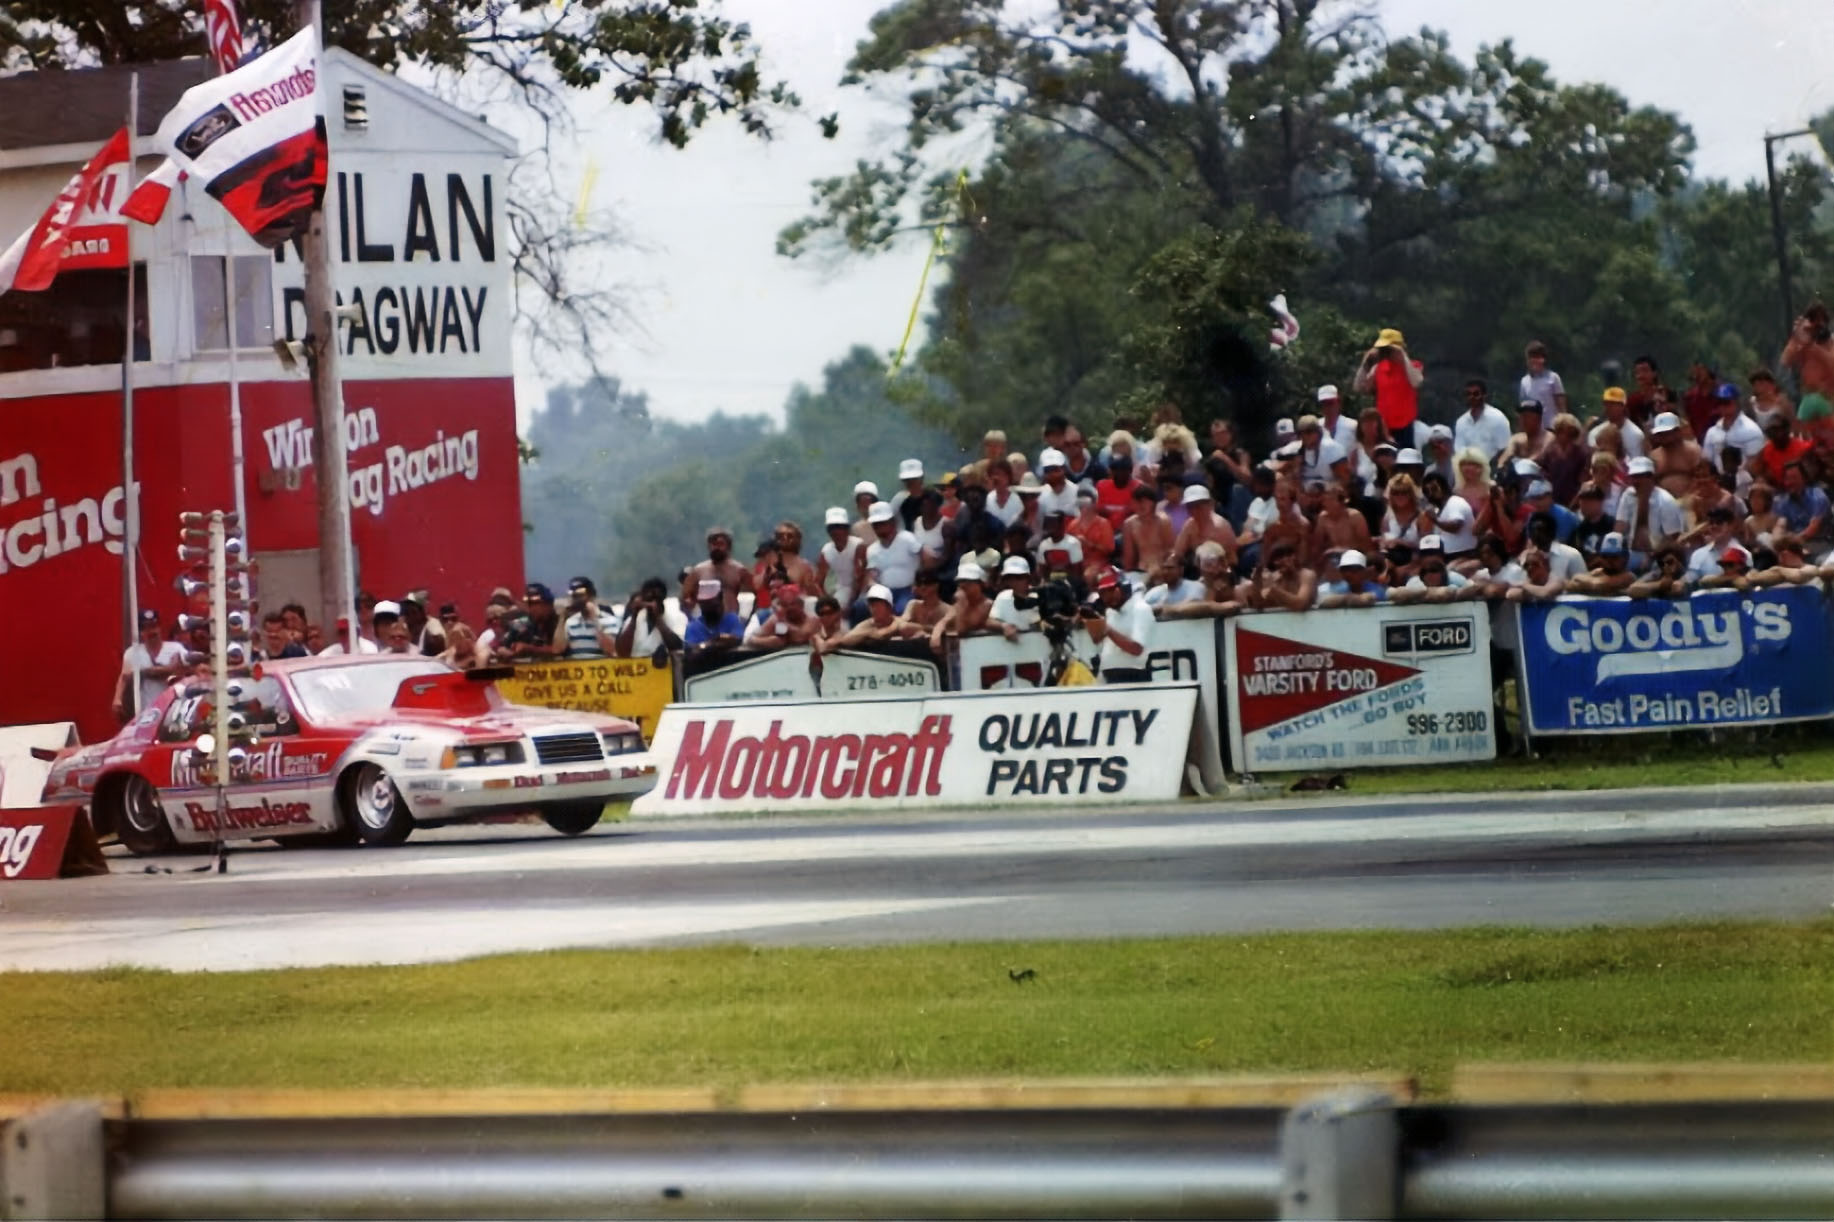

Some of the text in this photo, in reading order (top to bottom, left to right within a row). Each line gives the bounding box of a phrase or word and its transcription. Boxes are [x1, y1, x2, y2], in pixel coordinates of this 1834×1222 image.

[275, 172, 495, 262] ILAN
[283, 286, 487, 355] DAGWAY
[263, 407, 380, 470] Wion
[349, 430, 479, 515] ag Racing
[0, 482, 140, 574] cing
[1419, 627, 1468, 646] FORD
[1544, 600, 1792, 685] Goody's
[551, 667, 584, 681] MILD
[590, 666, 608, 679] TO
[614, 664, 648, 677] WILD
[847, 672, 925, 690] 278-4040
[1243, 668, 1378, 696] VARSITY FORD
[1254, 652, 1334, 673] STANFORD'S
[523, 681, 633, 700] GIVE US A CALL
[1568, 686, 1782, 725] Fast Pain Relief
[978, 709, 1161, 752] QUALITY
[1267, 712, 1326, 741] WATCH
[1331, 700, 1363, 720] THE
[1407, 710, 1488, 735] 996-2300
[664, 713, 953, 800] Motorcraft
[985, 756, 1129, 796] PARTS
